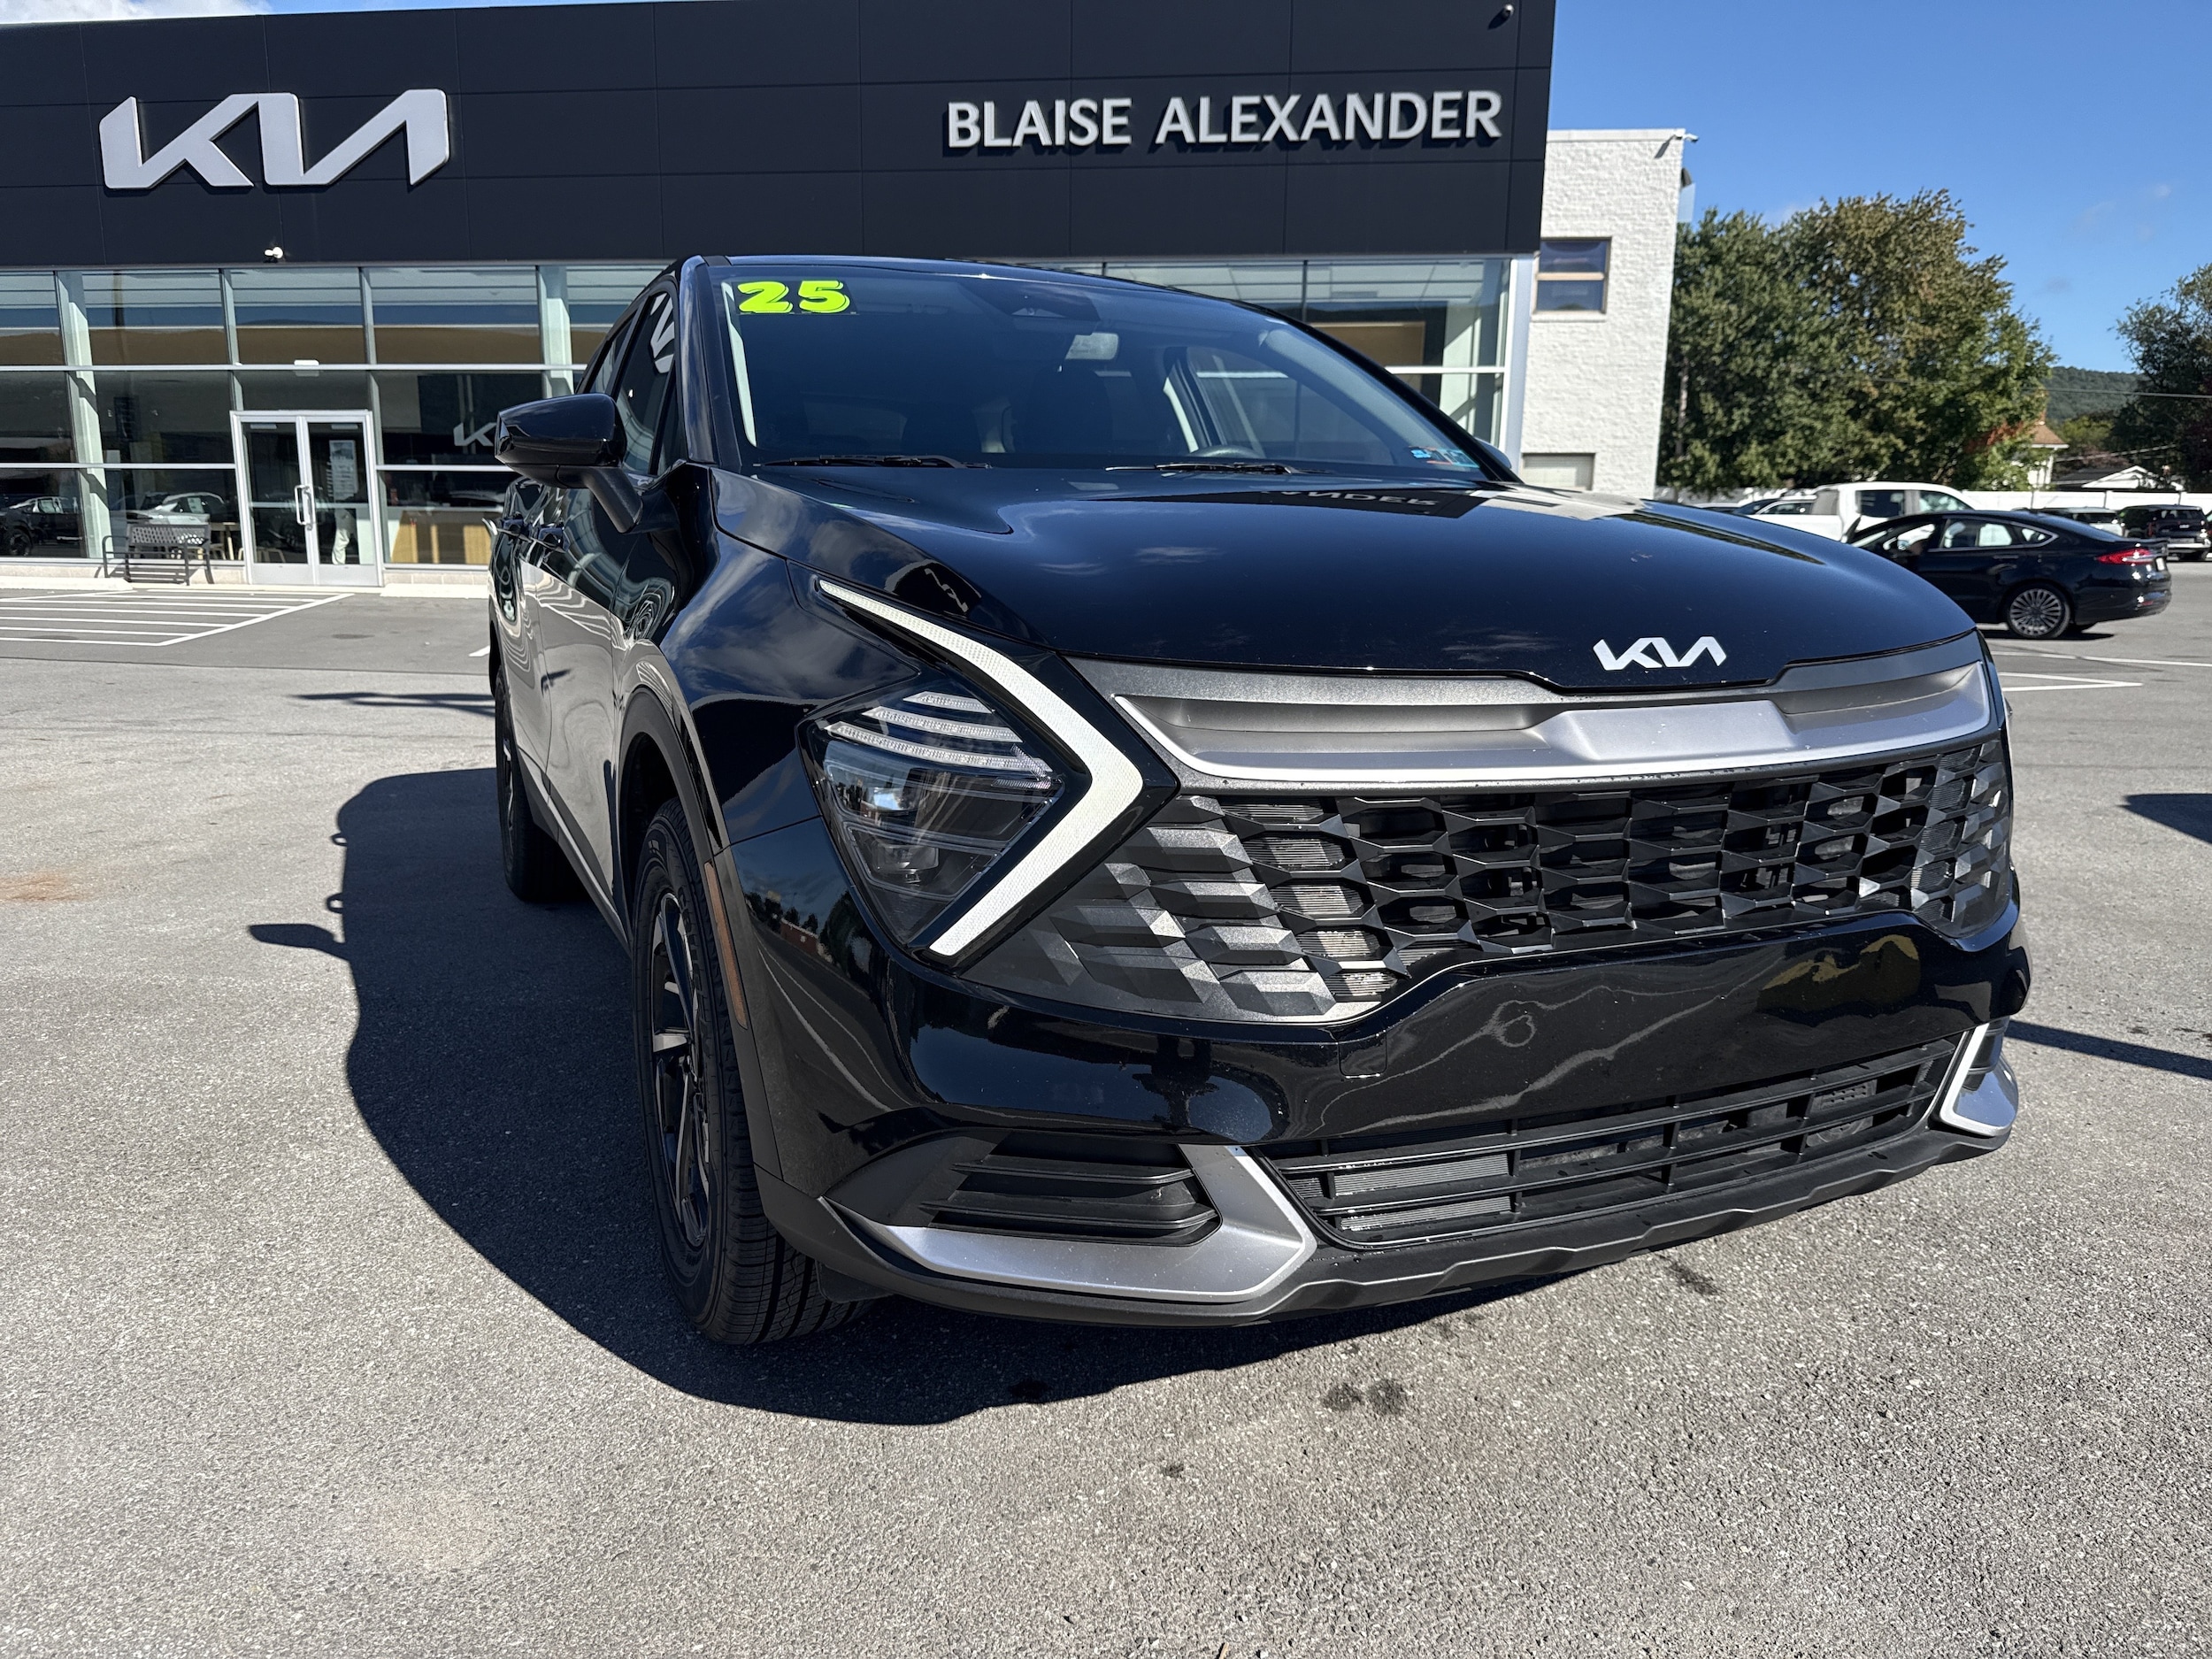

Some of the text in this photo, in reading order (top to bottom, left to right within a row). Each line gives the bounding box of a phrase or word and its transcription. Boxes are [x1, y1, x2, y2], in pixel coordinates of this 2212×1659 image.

[99, 88, 449, 189] KIA
[948, 90, 1502, 148] BLAISE ALEXANDER
[737, 280, 850, 313] 25
[1593, 636, 1727, 671] KIA
